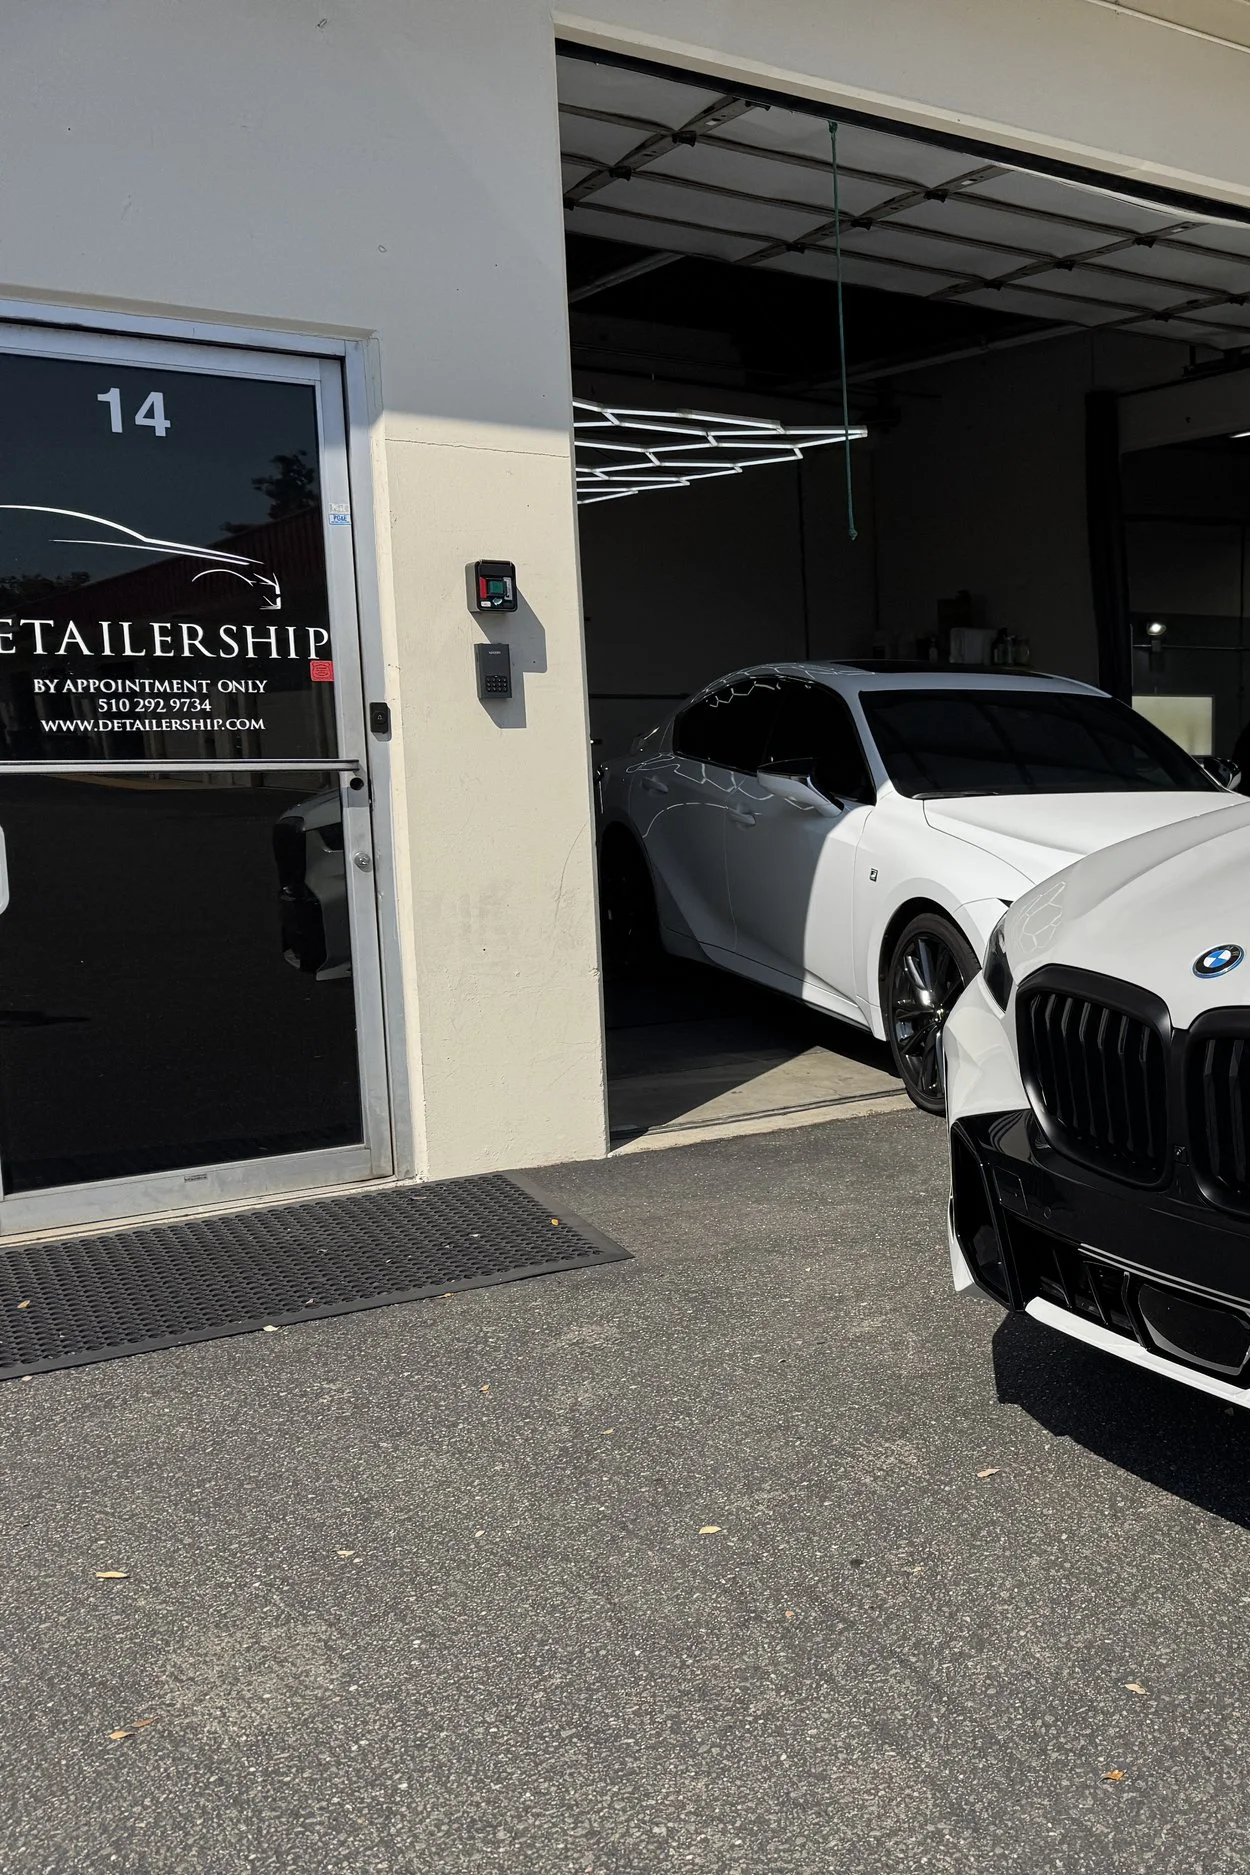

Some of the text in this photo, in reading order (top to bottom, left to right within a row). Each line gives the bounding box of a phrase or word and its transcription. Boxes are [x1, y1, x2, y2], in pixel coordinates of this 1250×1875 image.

[97, 387, 171, 437] 14
[33, 679, 268, 693] BY APPOINTMENT ONLY
[98, 698, 212, 712] 510 292 9734
[41, 718, 266, 732] WWW.DETAILERSHIP.COM
